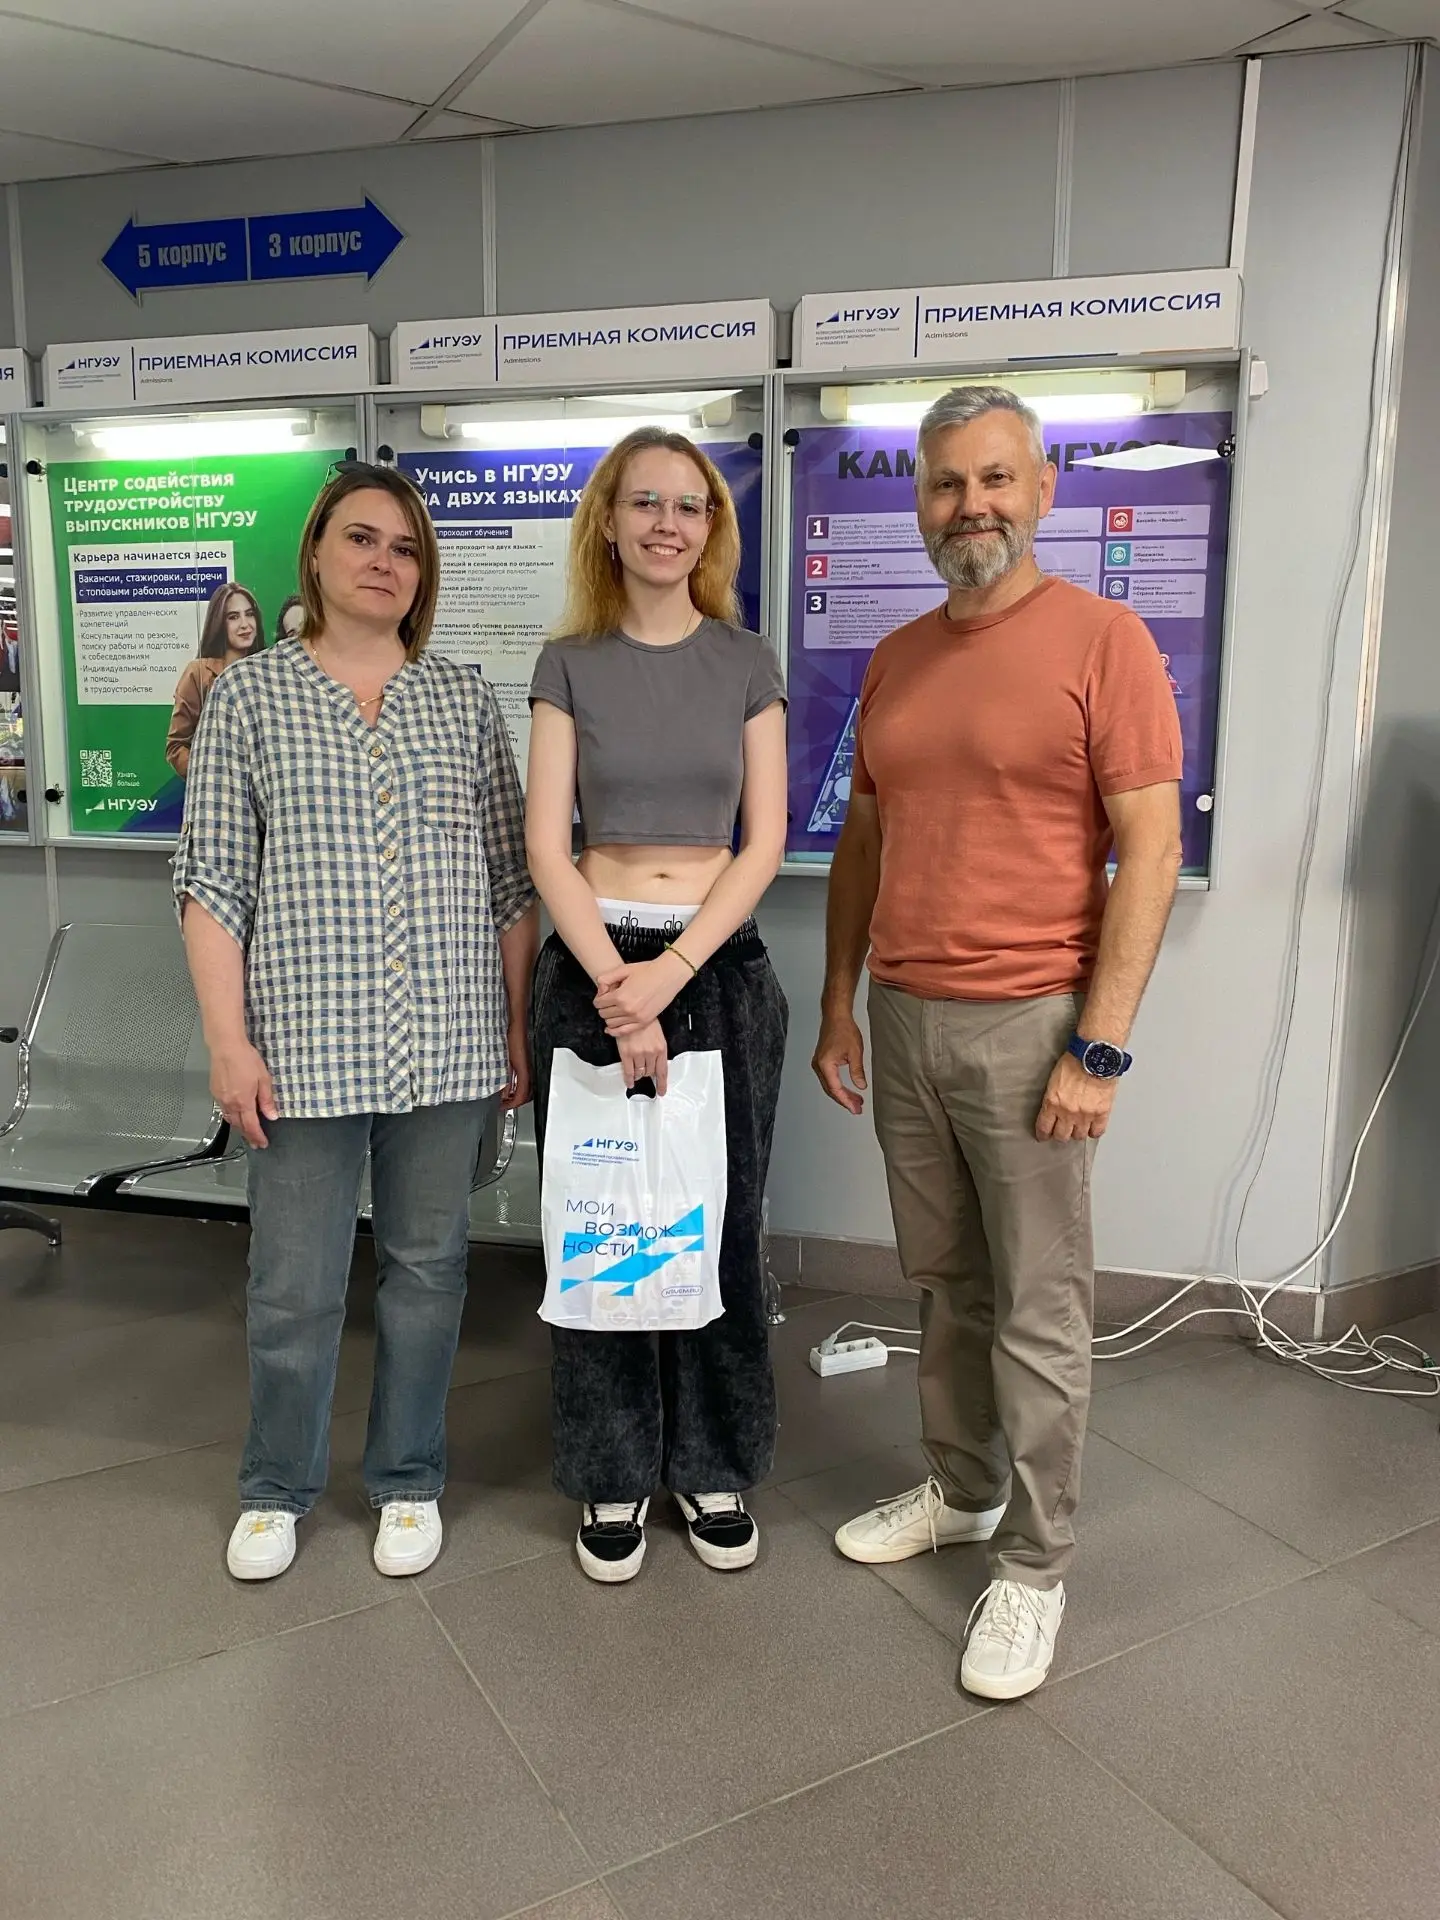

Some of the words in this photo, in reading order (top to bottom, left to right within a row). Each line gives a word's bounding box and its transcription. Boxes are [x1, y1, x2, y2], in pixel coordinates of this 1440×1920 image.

[269, 233, 282, 258] 3
[289, 229, 362, 257] корпус
[138, 244, 151, 268] 5
[157, 240, 227, 269] корпус
[844, 307, 900, 321] НГУЭУ
[924, 301, 1062, 324] ПРИЕМНАЯ
[1069, 292, 1221, 316] КОМИССИЯ
[433, 334, 482, 349] НГУЭУ
[503, 329, 621, 351] ПРИЕМНАЯ
[626, 321, 756, 344] КОМИССИЯ
[924, 330, 968, 339] Admissions
[78, 356, 121, 369] НГУЭУ
[138, 352, 241, 371] ПРИЕМНАЯ
[246, 345, 358, 366] КОМИССИЯ
[838, 449, 916, 479] КАМ
[503, 463, 574, 483] НГУЭУ
[195, 510, 258, 529] НГУЭУ
[438, 529, 473, 538] проходит
[474, 528, 509, 537] обучение
[813, 519, 824, 537] 1
[73, 552, 120, 564] Карьера
[123, 551, 191, 561] начинается
[195, 550, 227, 561] здесь
[811, 560, 823, 575] 2
[78, 573, 123, 584] Вакансии,
[125, 572, 183, 584] стажировки,
[186, 572, 222, 582] встречи
[85, 588, 130, 597] топовыми
[132, 585, 207, 598] работодателями
[810, 595, 822, 612] 3
[114, 609, 178, 618] управленческих
[80, 620, 129, 628] компетенций
[81, 632, 133, 641] Консультации
[108, 642, 137, 651] работы
[149, 665, 177, 673] подход
[107, 798, 158, 812] НГУЭУ
[566, 1199, 615, 1216] МОИ
[584, 1221, 684, 1240] ВОЗМОЖ-
[563, 1240, 635, 1257] НОСТИ
